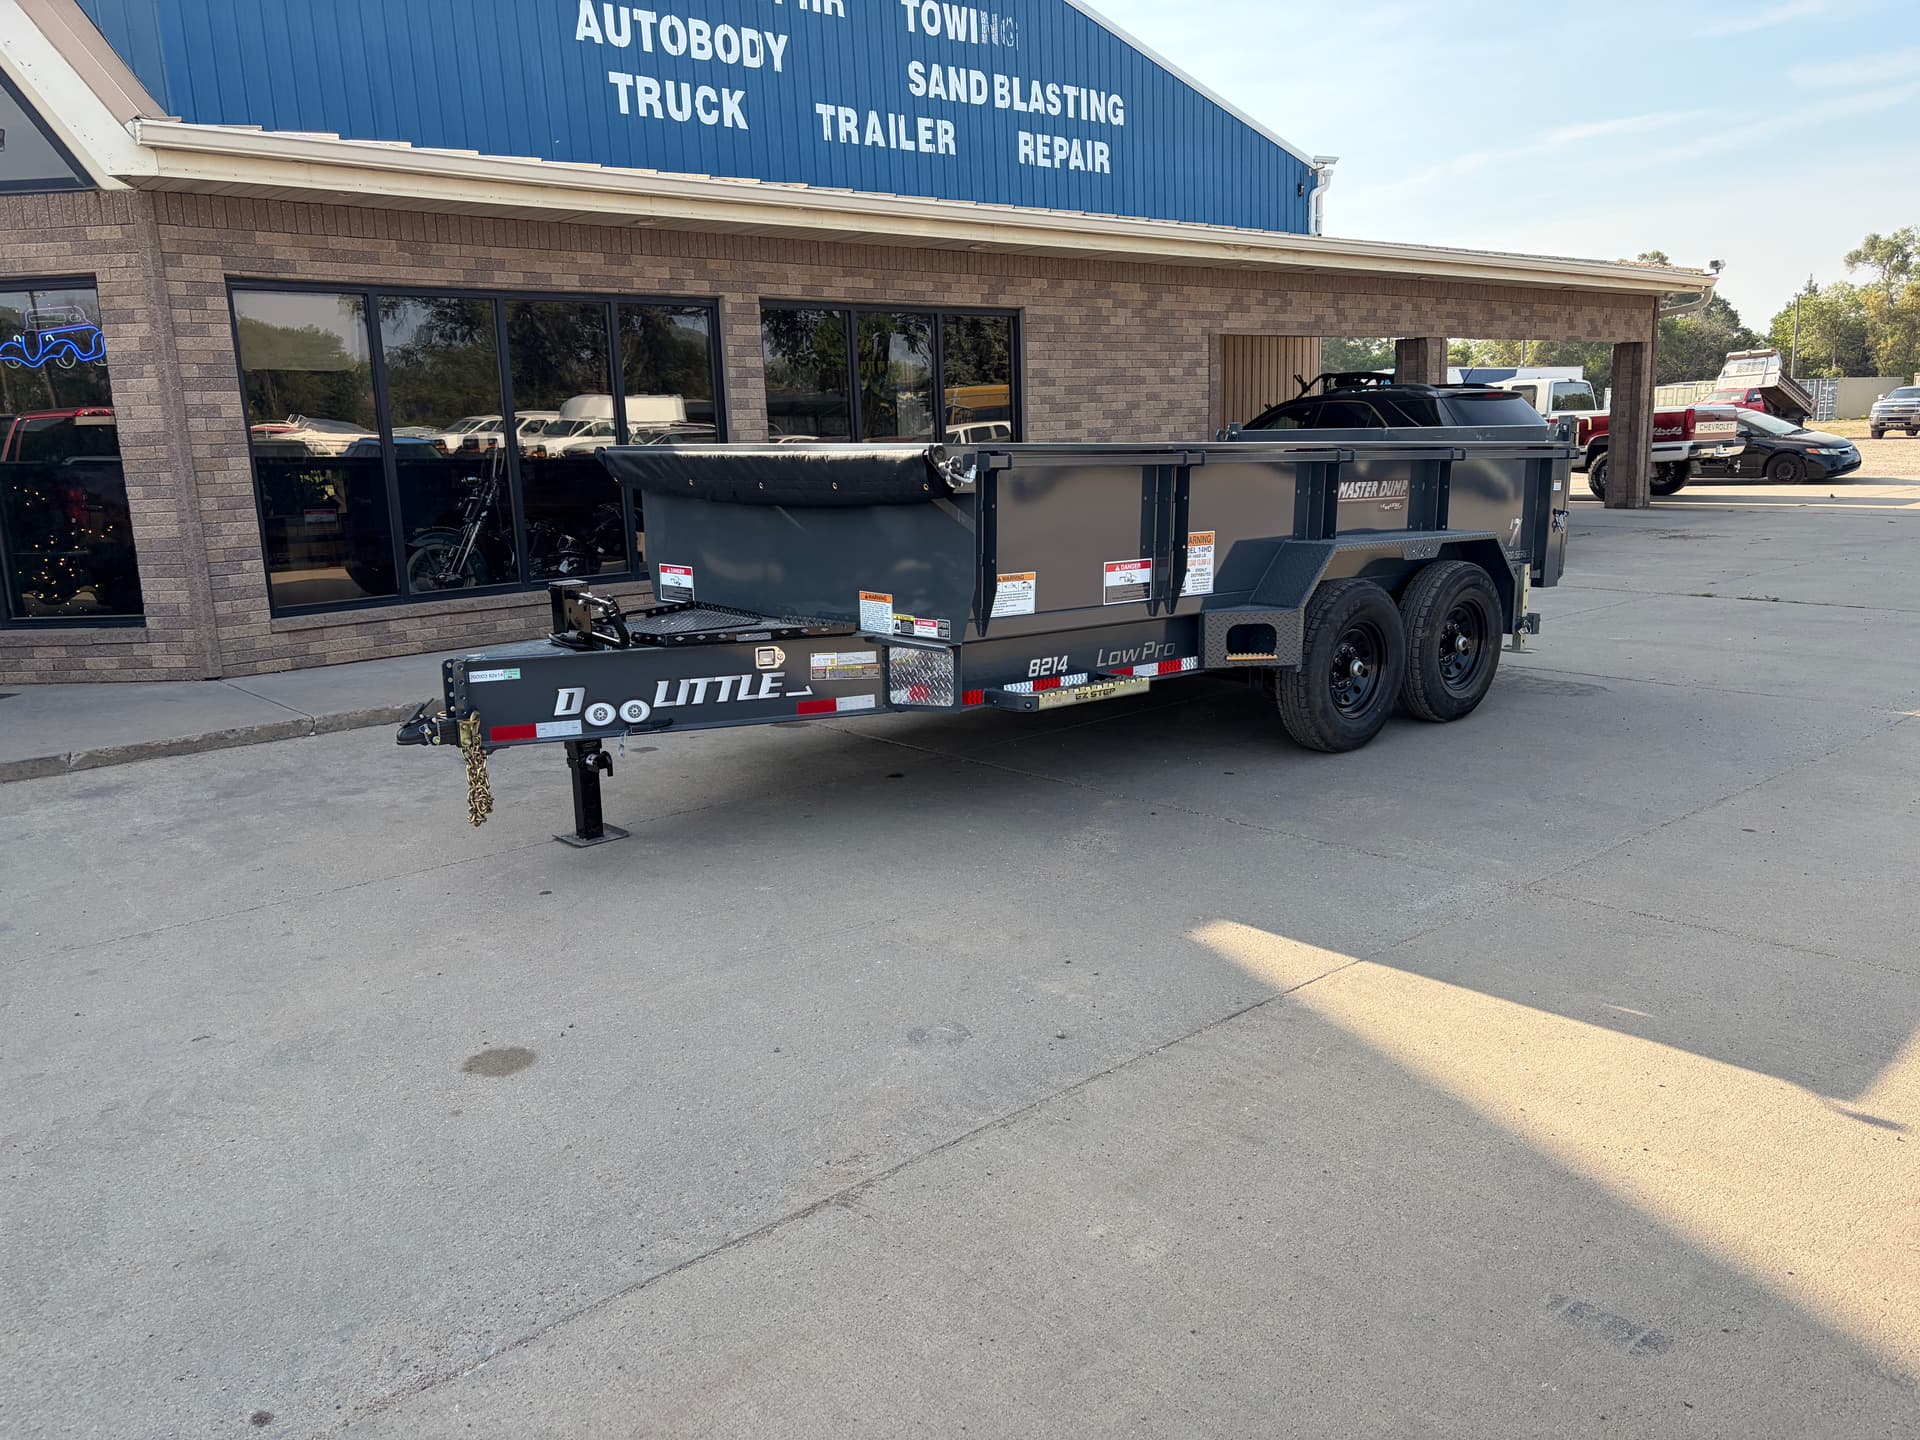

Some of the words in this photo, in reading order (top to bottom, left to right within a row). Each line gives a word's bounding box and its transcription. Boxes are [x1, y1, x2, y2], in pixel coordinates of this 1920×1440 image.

[576, 0, 788, 72] AUTOBODY
[608, 71, 749, 130] TRUCK
[816, 103, 956, 156] TRAILER
[1018, 131, 1110, 174] REPAIR
[1699, 423, 1733, 431] CHEVROLET
[1338, 481, 1378, 499] MASTER
[1379, 480, 1408, 497] DUMP
[1188, 534, 1212, 545] ARNING
[1121, 562, 1142, 571] DANGER
[1028, 655, 1069, 678] 8214
[1075, 689, 1089, 700] EZ
[1091, 688, 1116, 698] STEP
